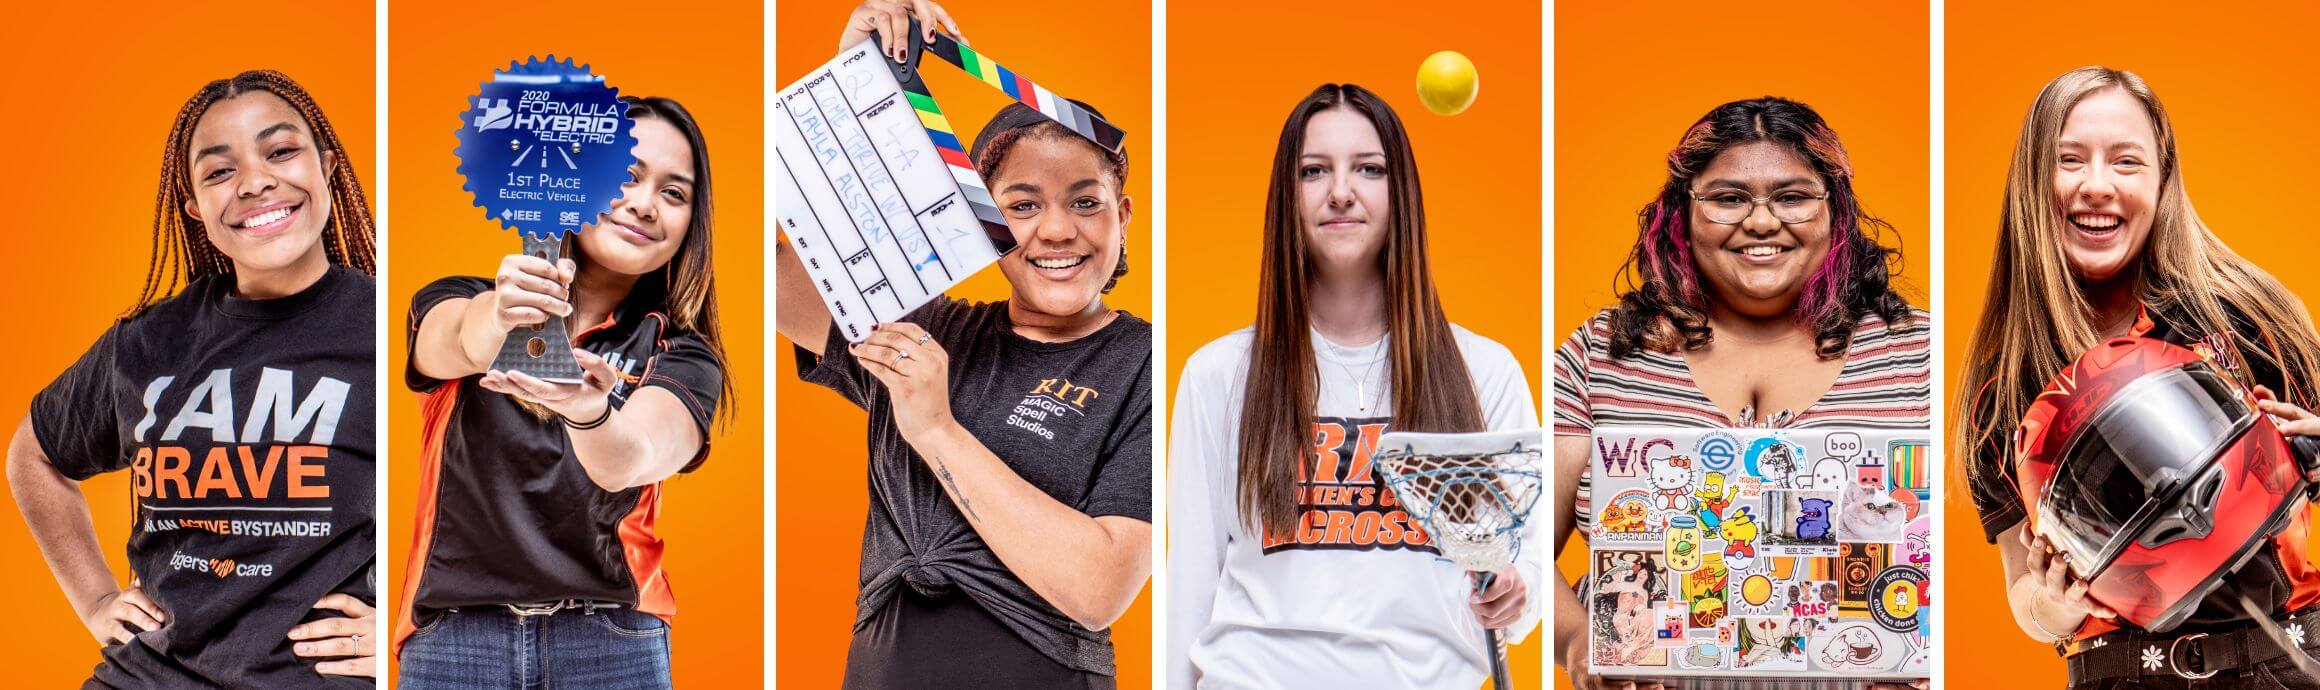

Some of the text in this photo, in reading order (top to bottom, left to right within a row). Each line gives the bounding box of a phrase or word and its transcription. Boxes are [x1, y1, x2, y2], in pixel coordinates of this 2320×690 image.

[842, 50, 866, 68] ROLL
[808, 72, 831, 89] PROD
[845, 69, 874, 101] 2
[521, 90, 550, 101] 2020
[786, 87, 805, 102] DIR
[517, 100, 619, 117] FORMULA
[866, 99, 895, 120] SCENE
[514, 113, 619, 134] HYBRID
[846, 127, 890, 192] THRIVE
[507, 172, 581, 189] 1ST PLACE
[793, 106, 889, 244] JAYLA ALSTON
[499, 188, 586, 203] ELECTRIC VEHICLE
[513, 209, 541, 221] IEEE
[559, 211, 580, 223] SAE
[931, 200, 955, 217] TAKE
[798, 237, 808, 249] EXT
[809, 257, 820, 270] DAY
[850, 251, 869, 266] CAM
[1029, 378, 1099, 408] RIT
[133, 366, 352, 446] I AM
[1013, 405, 1047, 422] Spell
[1021, 398, 1066, 417] MAGIC
[1006, 414, 1055, 440] Studios
[1298, 422, 1389, 484] RI
[1831, 438, 1856, 450] boo
[132, 445, 331, 500] BRAVE
[157, 519, 180, 531] AN
[179, 517, 231, 535] ACTIVE
[231, 519, 332, 537] BYSTANDER
[1607, 532, 1664, 541] ANPANMAN
[169, 550, 273, 577] tigers care
[1873, 598, 1916, 627] chicken done
